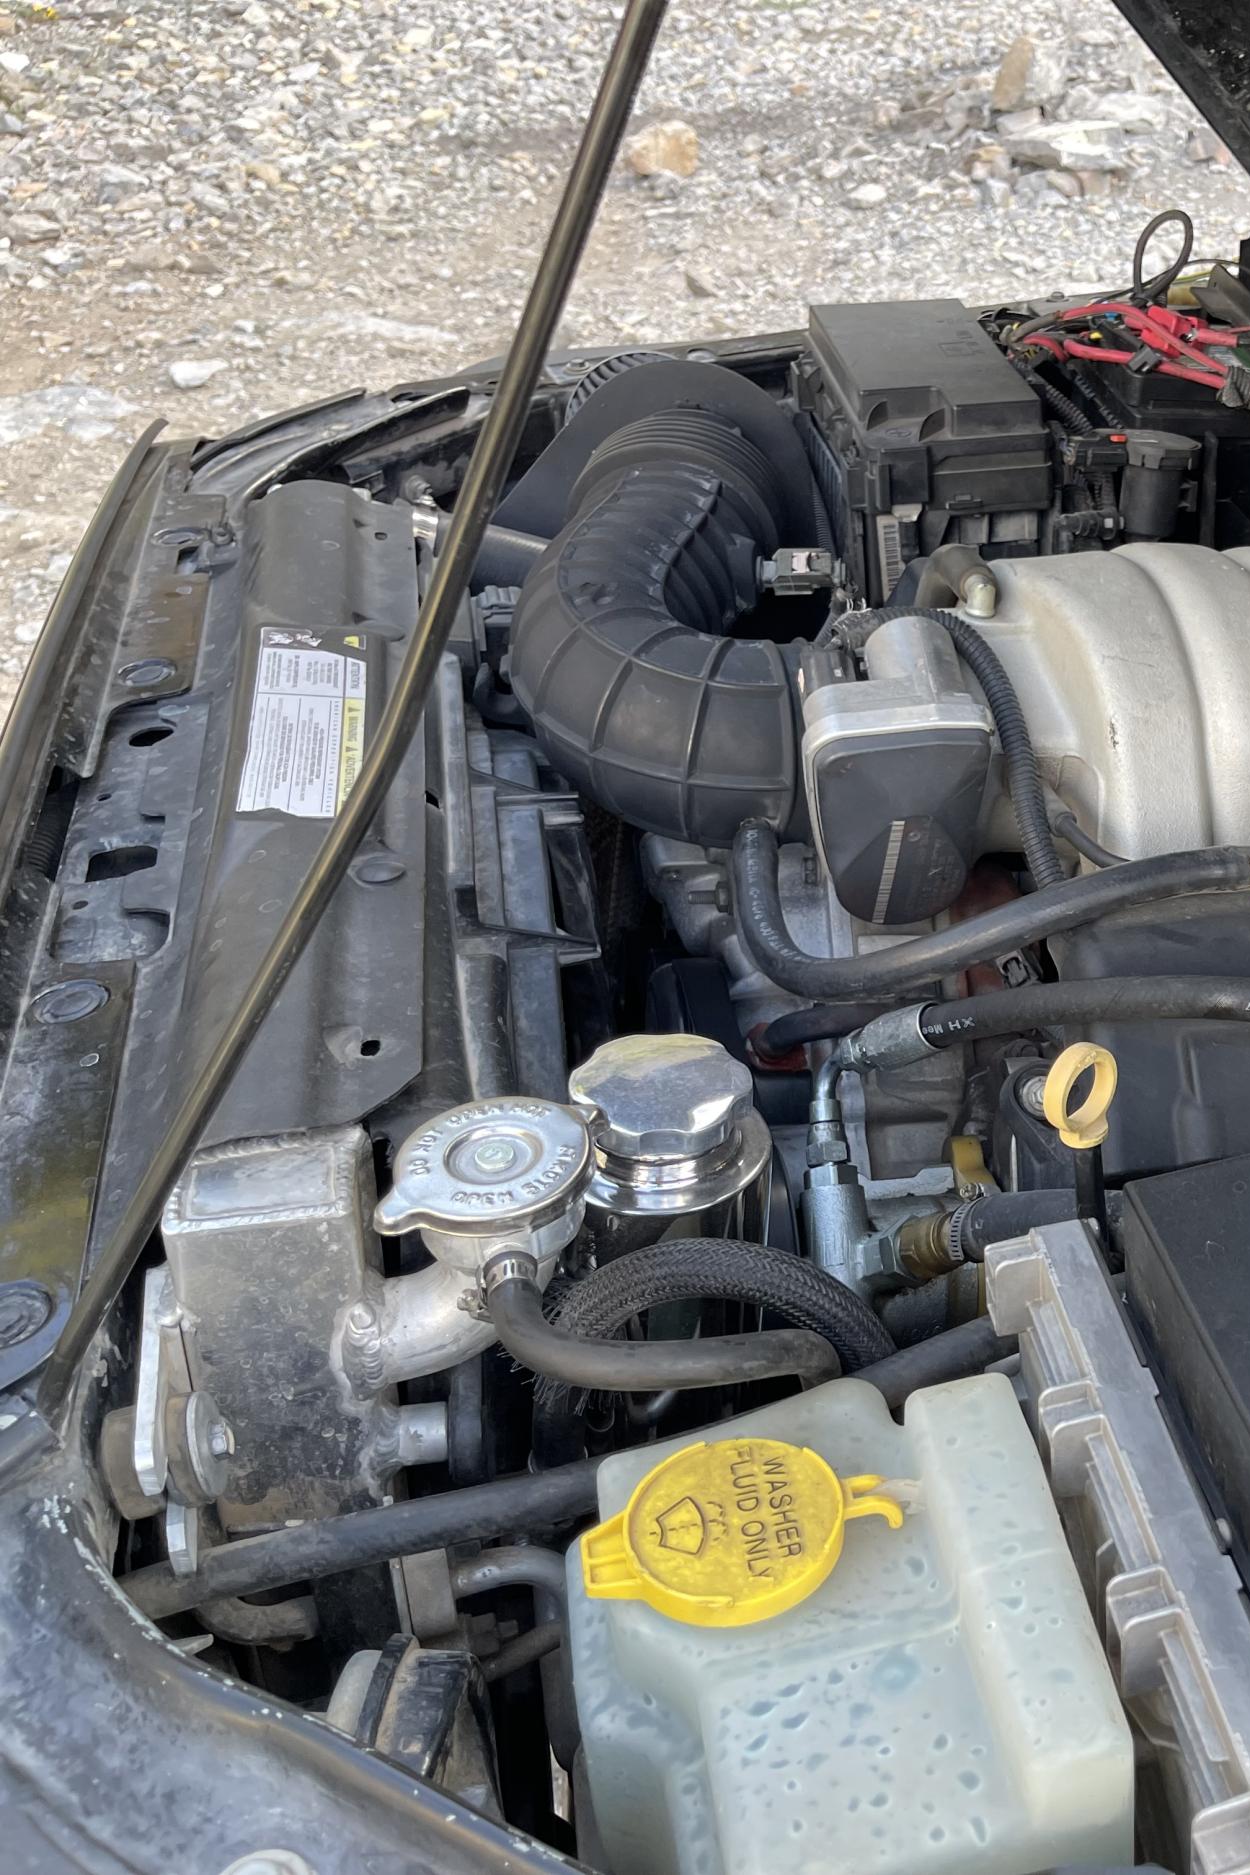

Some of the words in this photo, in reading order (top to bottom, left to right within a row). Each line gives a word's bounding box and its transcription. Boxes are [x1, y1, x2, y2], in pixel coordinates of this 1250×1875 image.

[729, 1447, 762, 1513] FLUID
[762, 1455, 802, 1559] WASHER
[740, 1520, 772, 1579] ONLY
